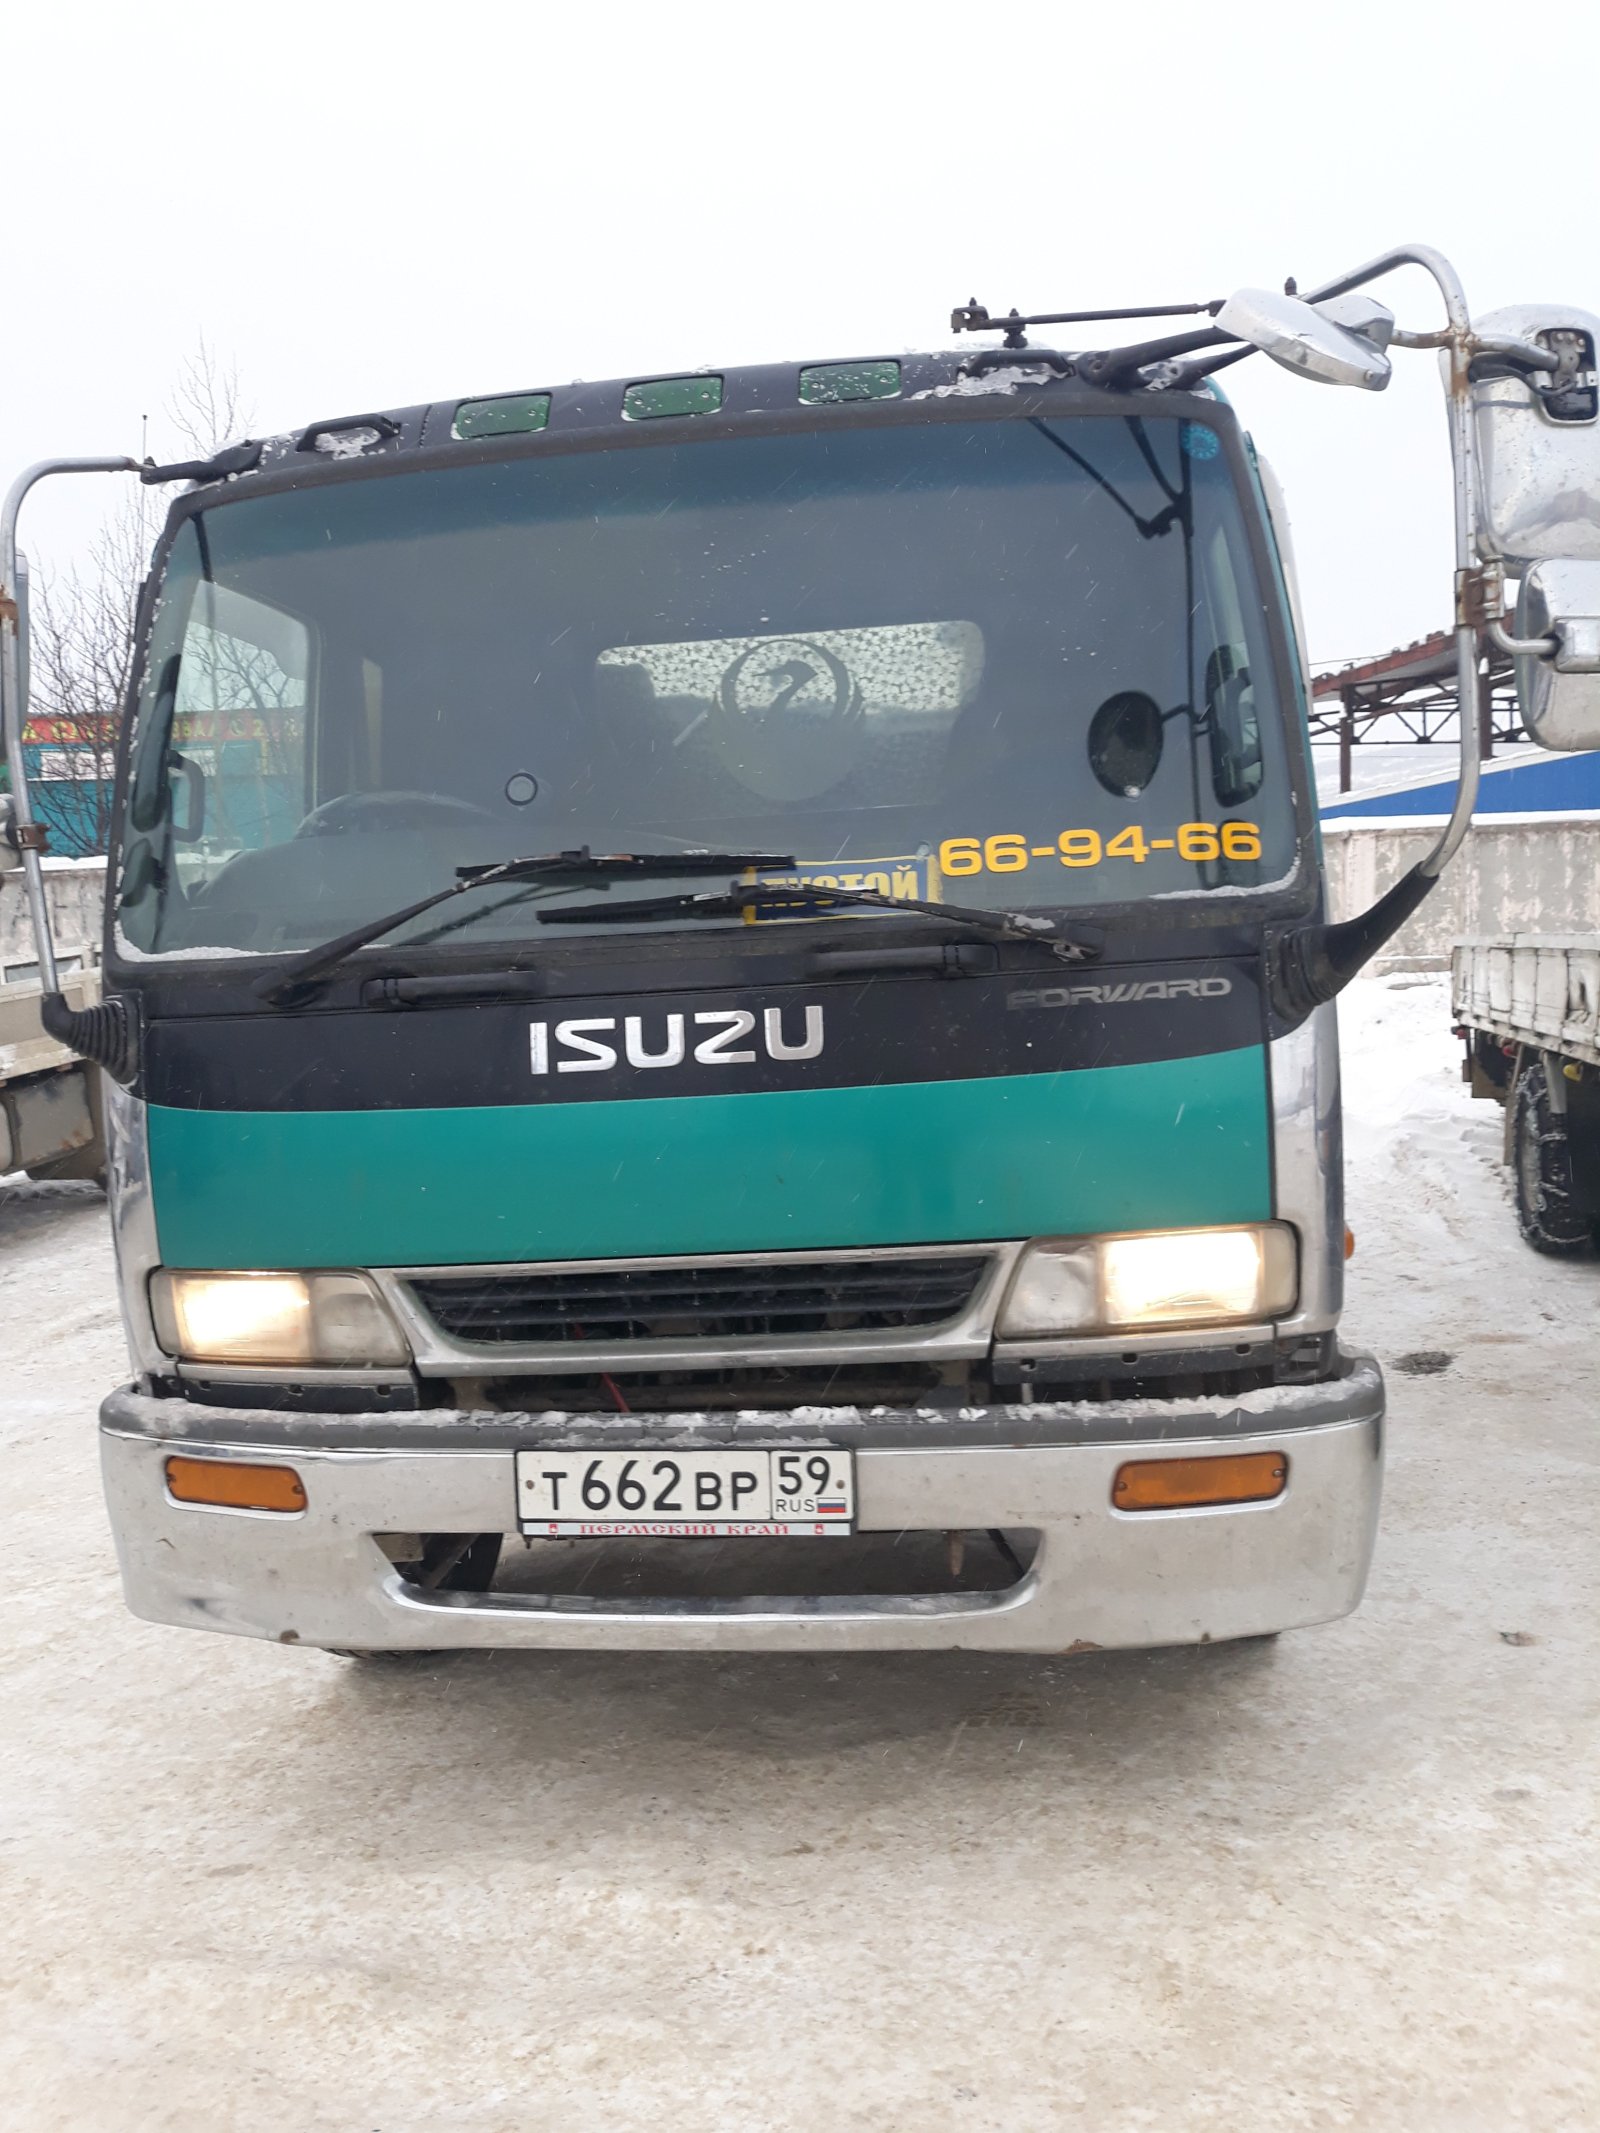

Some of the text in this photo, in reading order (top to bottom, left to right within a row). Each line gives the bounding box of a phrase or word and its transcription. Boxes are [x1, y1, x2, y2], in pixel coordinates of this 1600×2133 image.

[939, 822, 1262, 877] 66-94-66
[1006, 977, 1232, 1010] FORWARD
[529, 1005, 824, 1075] ISUZU
[778, 1456, 831, 1496] 59
[776, 1499, 816, 1513] RUS
[580, 1522, 790, 1536] ПЕРМСКИЙ КРАЙ
